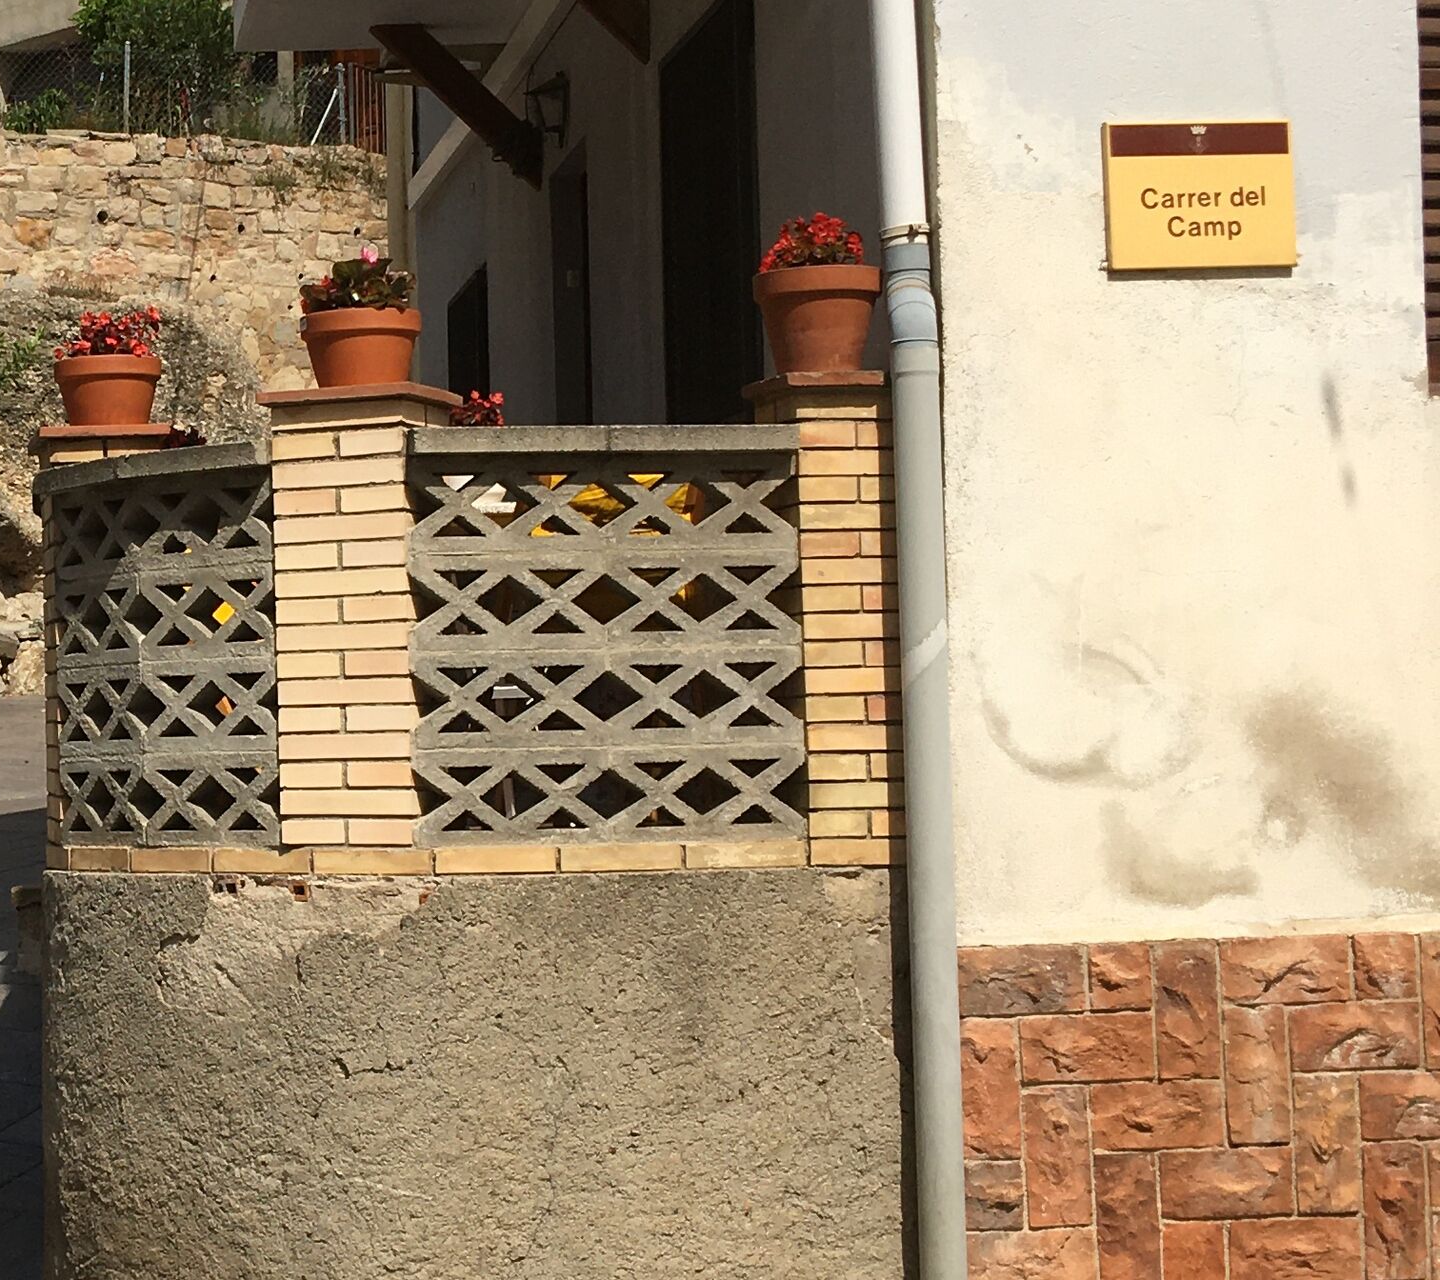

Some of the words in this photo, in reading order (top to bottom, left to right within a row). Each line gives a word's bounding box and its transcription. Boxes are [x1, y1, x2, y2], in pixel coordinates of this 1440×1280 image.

[1140, 187, 1222, 209] Carrer
[1229, 185, 1266, 207] del
[1167, 215, 1242, 240] Camp
